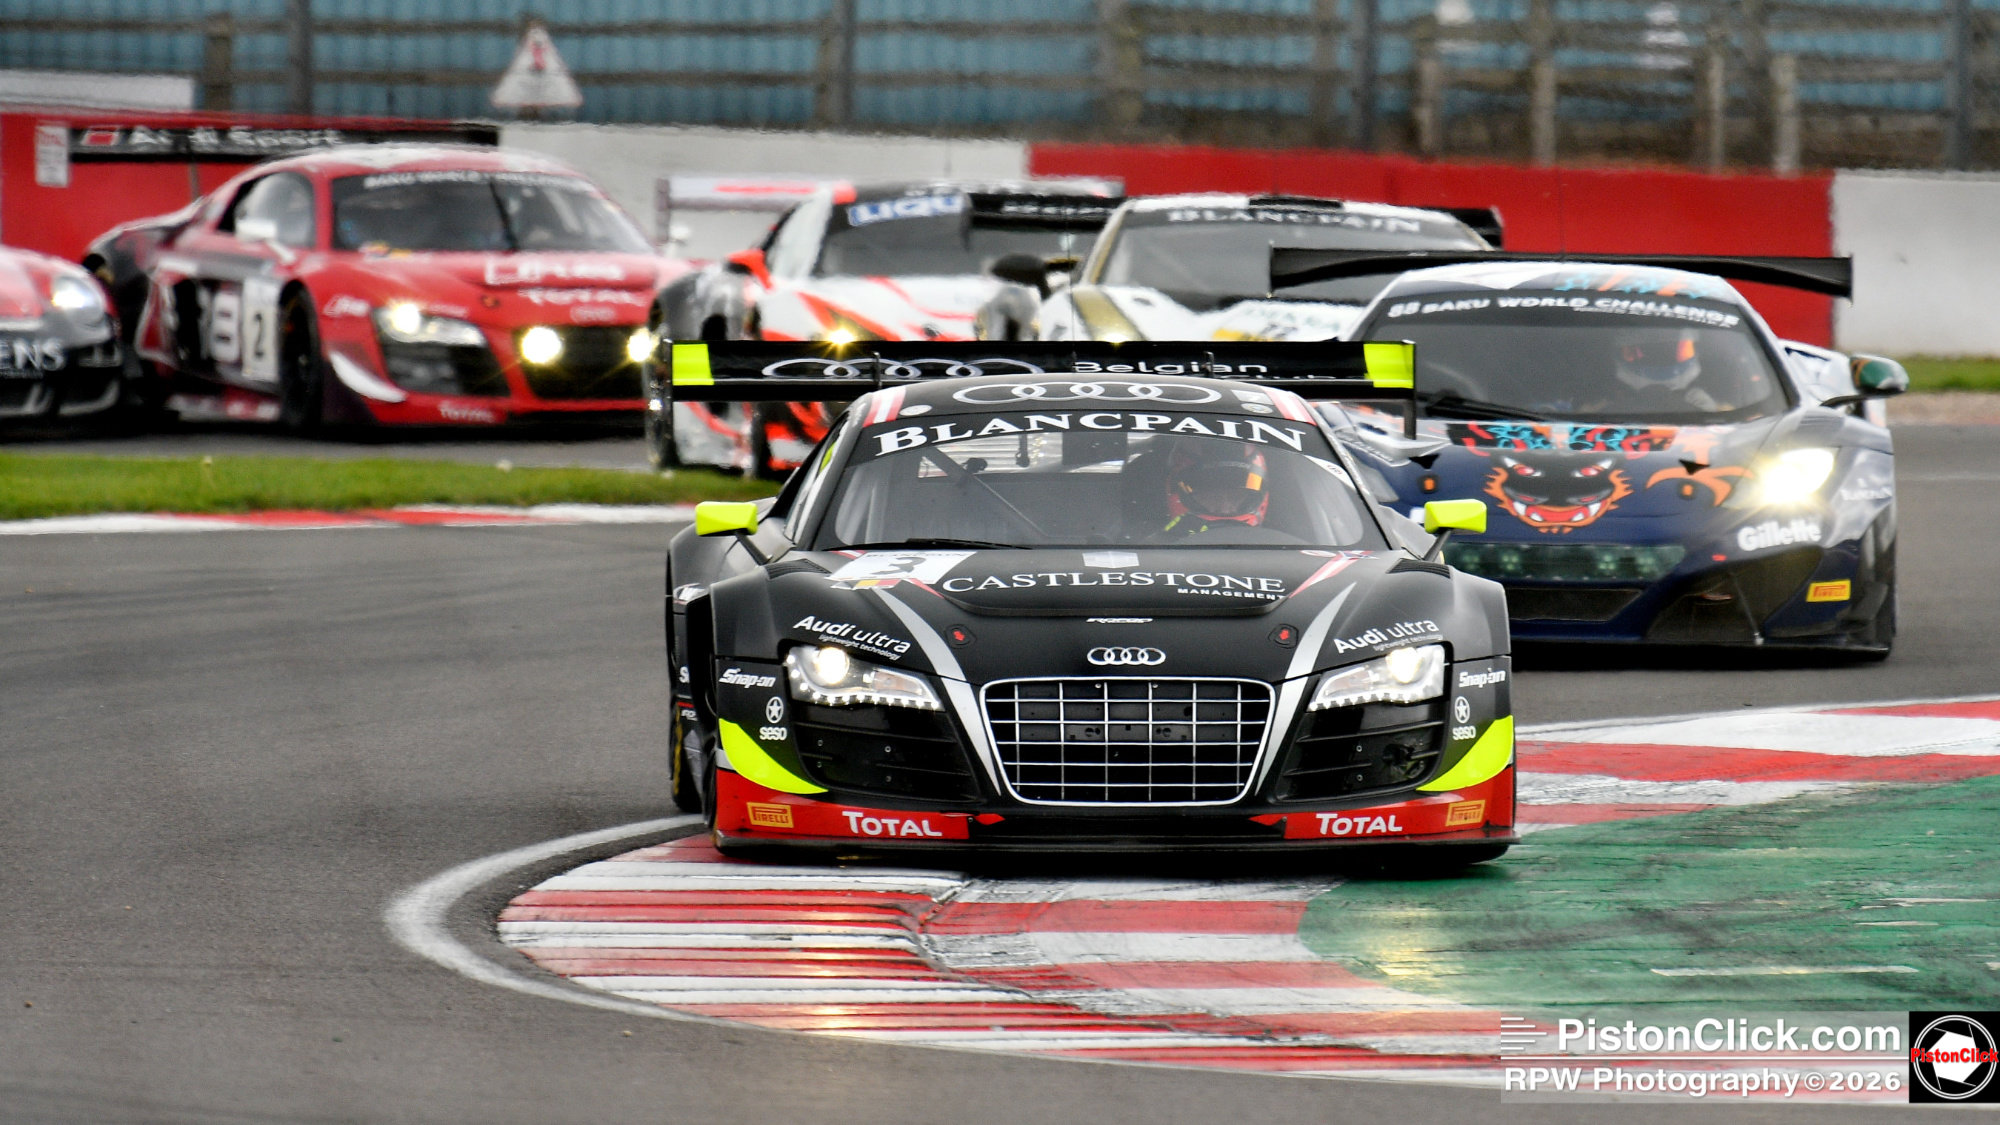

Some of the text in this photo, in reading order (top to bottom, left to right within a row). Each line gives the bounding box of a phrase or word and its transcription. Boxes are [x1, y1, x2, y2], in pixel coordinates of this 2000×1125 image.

[1167, 208, 1420, 233] BLANCPAIN
[1421, 299, 1491, 315] BAKU
[1497, 296, 1589, 309] WORLD
[1594, 297, 1740, 328] CHALLENGE
[1072, 361, 1268, 375] Belgian
[873, 413, 1306, 457] BLANCPAIN
[1737, 519, 1822, 551] Gillette
[870, 556, 927, 576] 3
[942, 572, 1286, 594] CASTLESTONE
[1177, 588, 1286, 601] MANAGEMENT
[793, 615, 911, 654] Audi ultra
[1333, 619, 1440, 654] Audi ultra
[718, 668, 776, 689] Snap-on
[1459, 667, 1506, 688] Snap-on
[759, 726, 788, 741] seso
[1452, 725, 1477, 740] seso
[753, 806, 790, 824] PIRELLI
[842, 811, 943, 837] TOTAL
[1316, 813, 1403, 836] TOTAL
